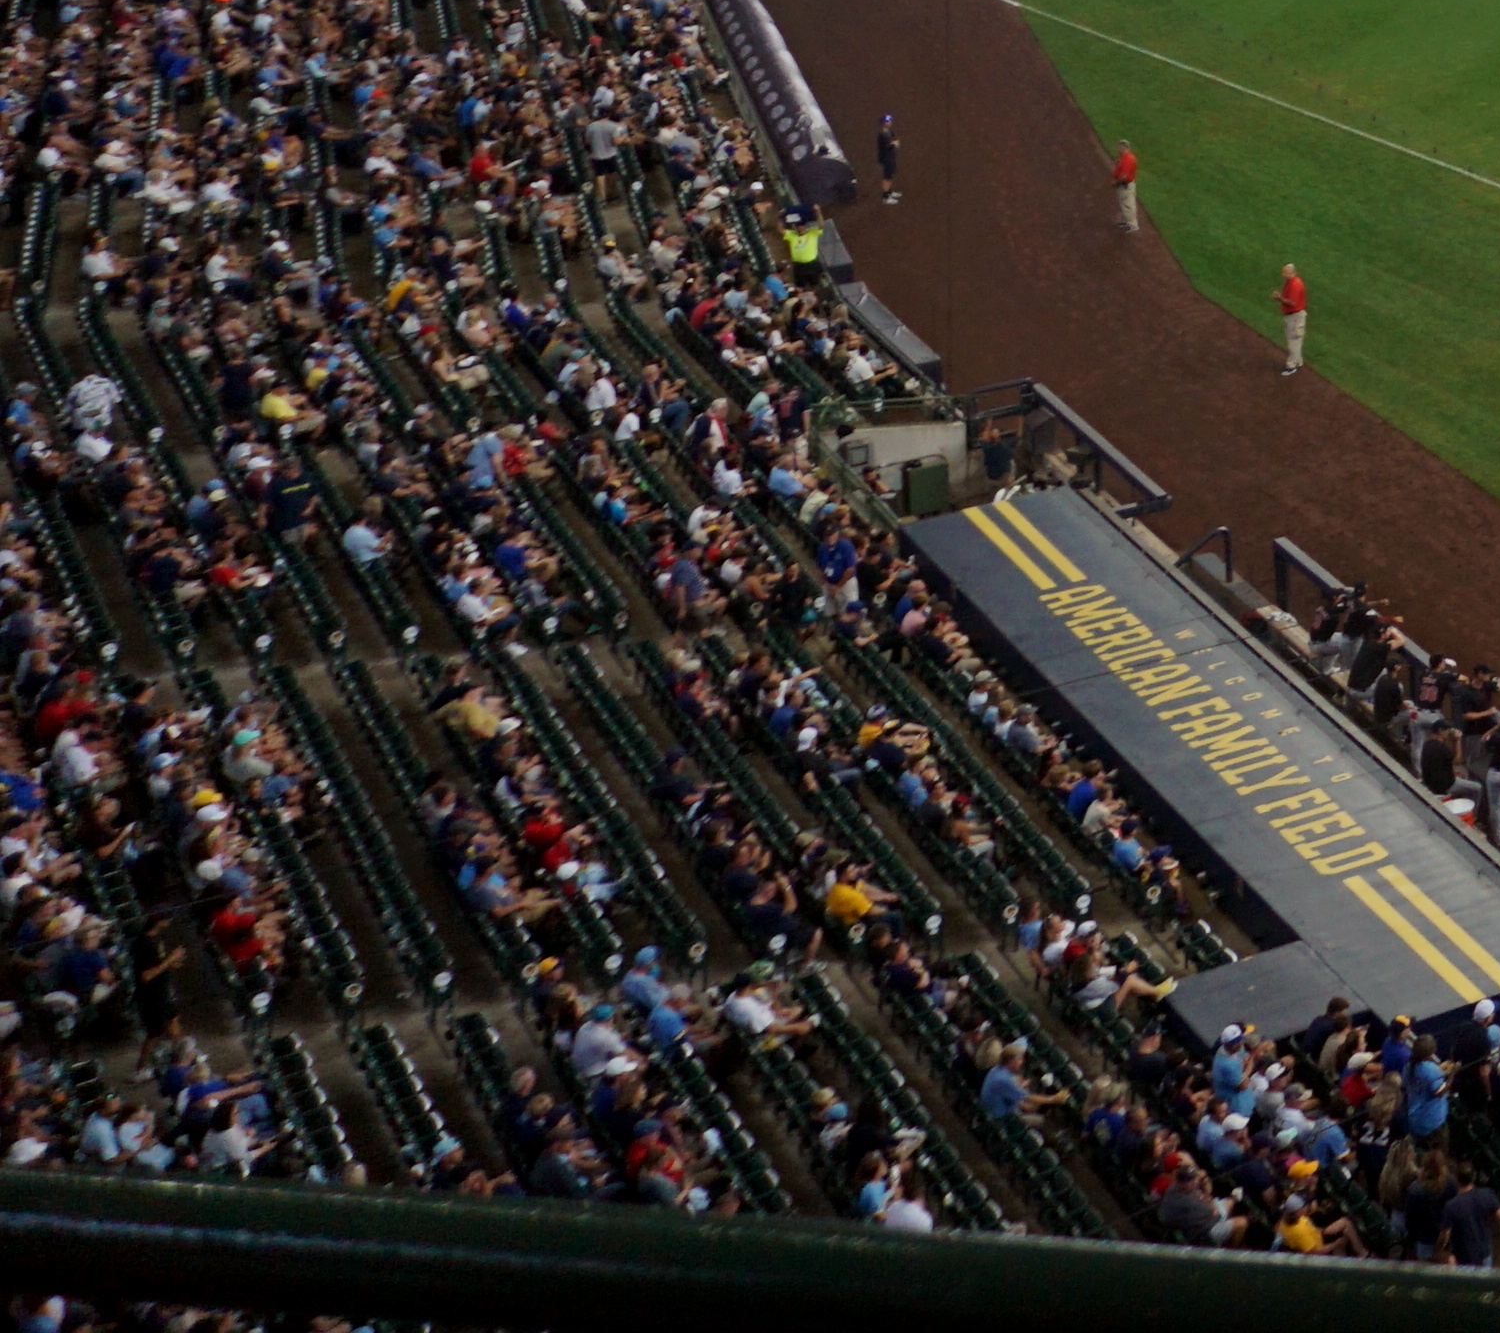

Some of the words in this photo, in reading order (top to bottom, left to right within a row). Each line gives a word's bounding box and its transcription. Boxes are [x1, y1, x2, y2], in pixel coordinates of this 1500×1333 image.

[1039, 585, 1213, 708] AMERICAN
[1155, 694, 1312, 797] FAMILY
[1254, 786, 1390, 878] FIELD
